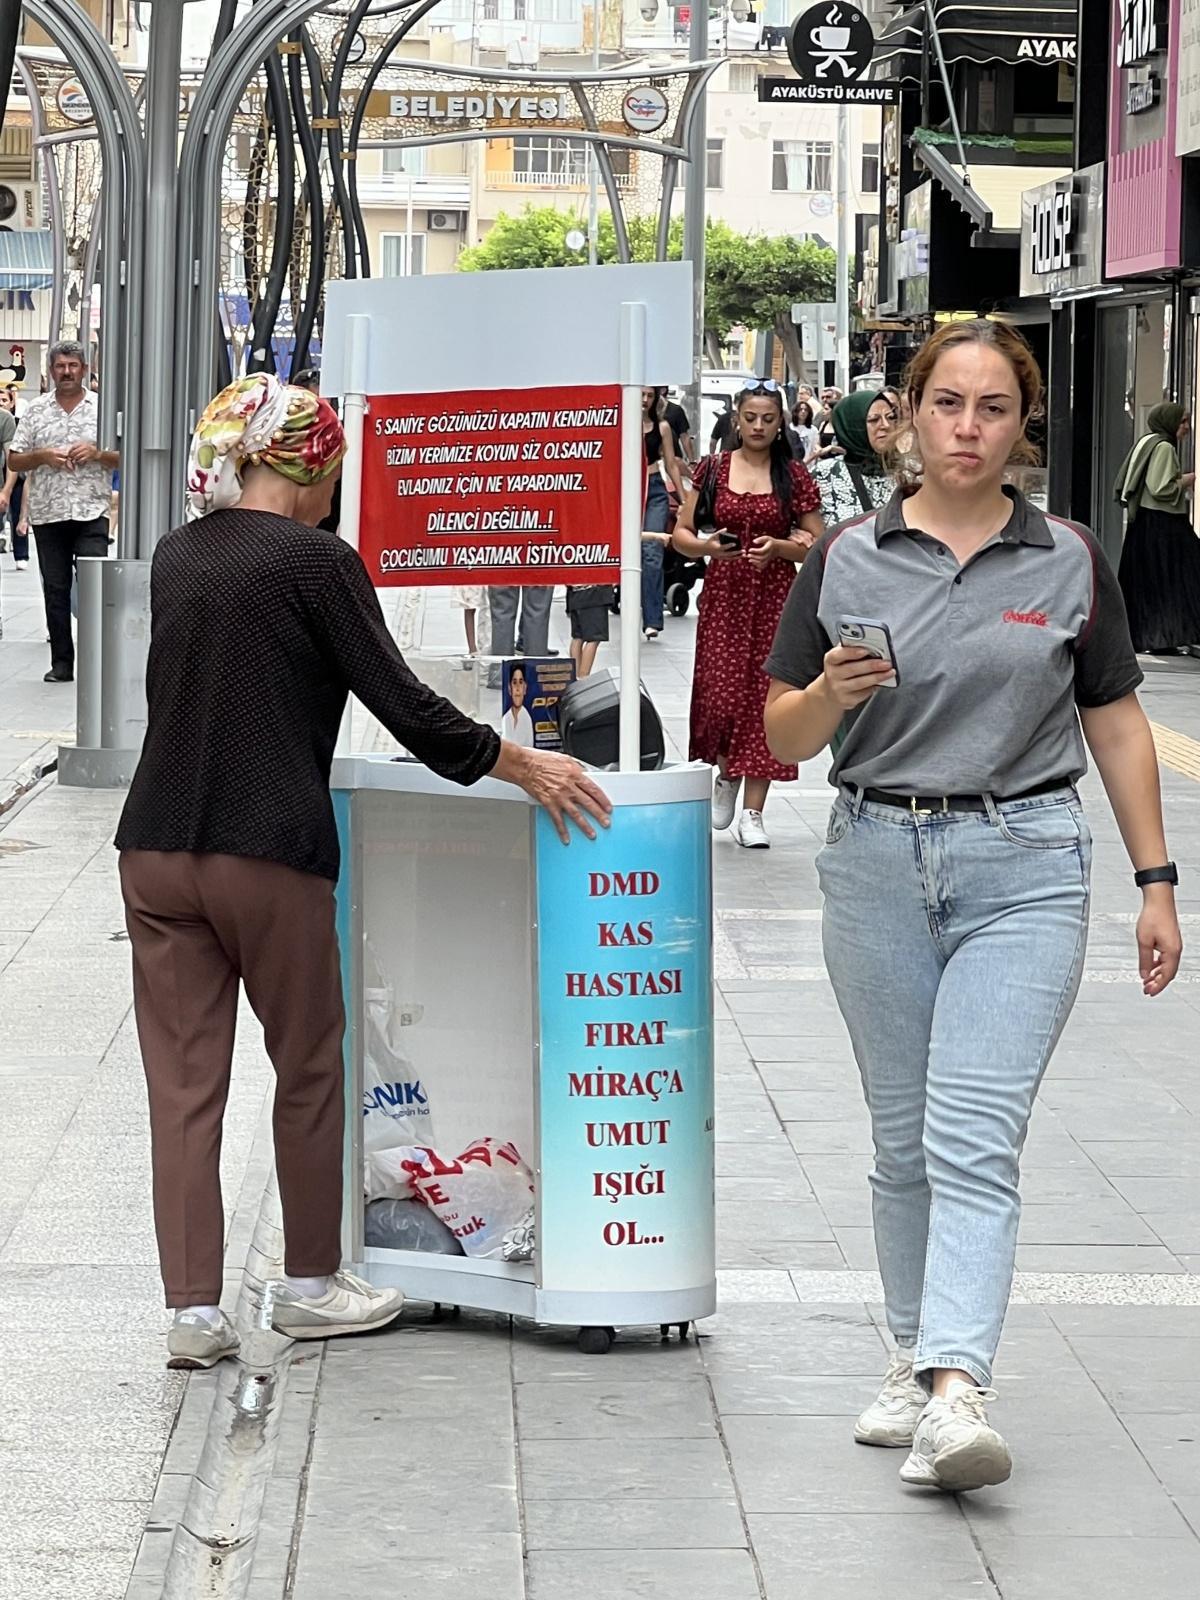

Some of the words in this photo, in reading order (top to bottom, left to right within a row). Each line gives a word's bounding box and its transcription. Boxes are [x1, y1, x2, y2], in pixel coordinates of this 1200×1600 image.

[1017, 39, 1076, 58] AYAK
[390, 92, 567, 119] BELEDİYESİ
[771, 85, 843, 98] AYAKÜSTÜ
[846, 88, 893, 100] KAHVE
[0, 290, 35, 310] IK
[375, 421, 383, 435] 5
[384, 414, 426, 435] SANİYE
[428, 410, 498, 433] GÖZÜNÜZÜ
[499, 411, 550, 431] KAPATIN
[553, 405, 619, 428] KENDİNİZİ
[386, 444, 415, 466] BİZİM
[418, 441, 472, 465] YERİMİZE
[475, 444, 519, 462] KOYUN
[520, 440, 540, 461] SİZ
[543, 441, 603, 460] OLSANIZ
[398, 476, 452, 497] EVLADINIZ
[455, 472, 483, 498] İÇİN
[486, 476, 503, 493] NE
[506, 474, 588, 493] YAPARDINIZ.
[427, 506, 481, 532] DİLENCİ
[380, 544, 449, 573] ÇOCUĞUMU
[453, 545, 523, 570] YAŞATMAK
[526, 541, 620, 566] İSTİYORUM...
[588, 871, 660, 897] DMD
[597, 921, 653, 947] KAS
[565, 969, 682, 997] HASTASI
[584, 1021, 668, 1047] FIRAT
[568, 1065, 684, 1102] MİRAÇ'A
[584, 1120, 671, 1147] UMUT
[592, 1163, 666, 1203] IŞIĞI
[603, 1221, 665, 1246] OL...
